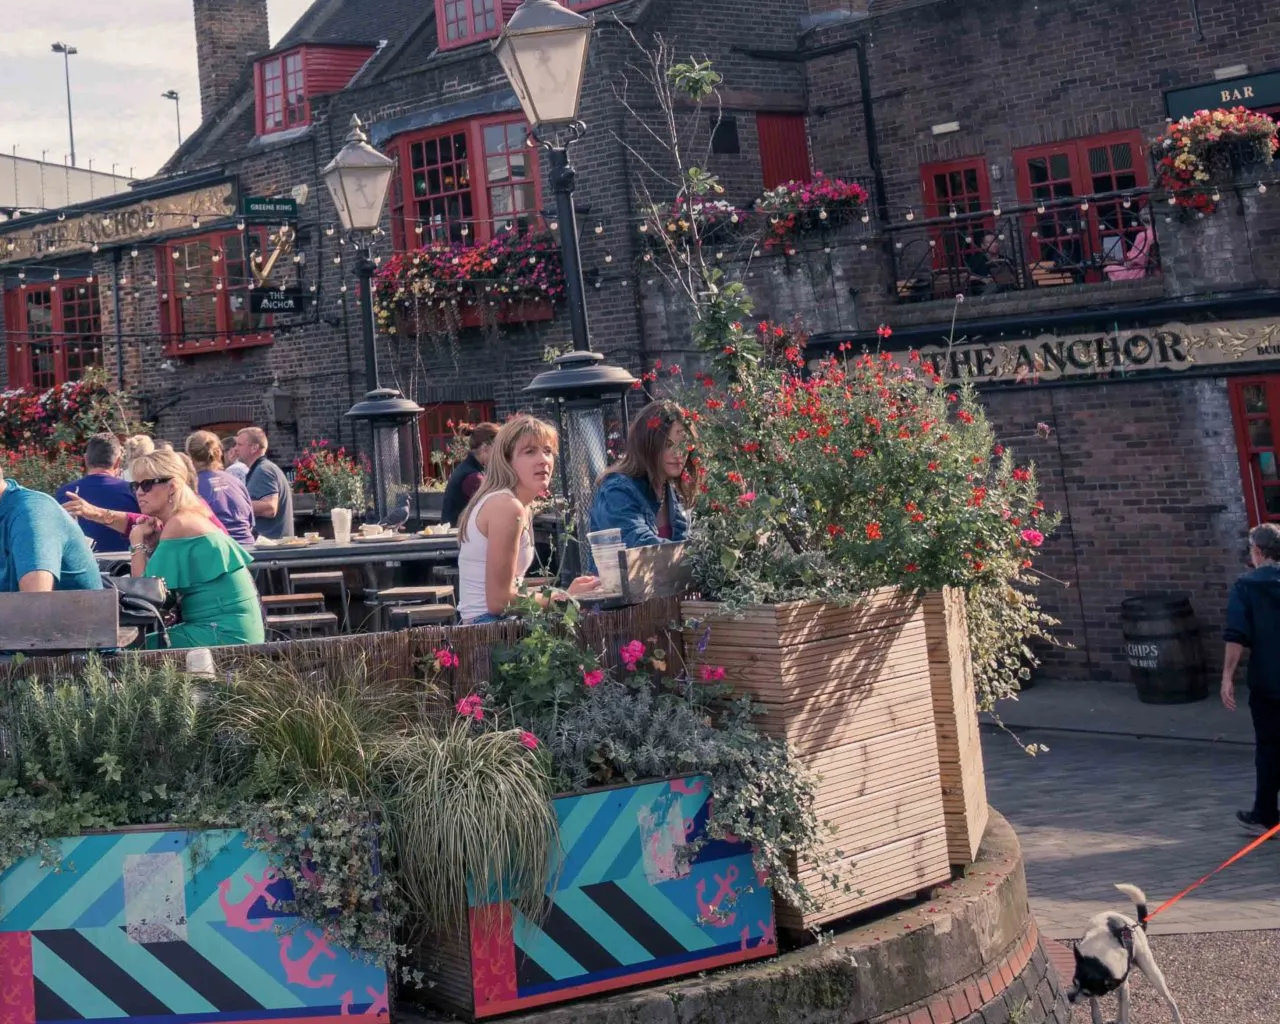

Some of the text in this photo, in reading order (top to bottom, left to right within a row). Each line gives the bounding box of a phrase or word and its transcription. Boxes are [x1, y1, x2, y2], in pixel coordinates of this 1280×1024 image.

[1221, 86, 1254, 102] BAR
[32, 205, 157, 253] THE ANCHOR
[260, 292, 294, 309] THE ANCHOR
[922, 330, 1188, 379] THE ANCHOR
